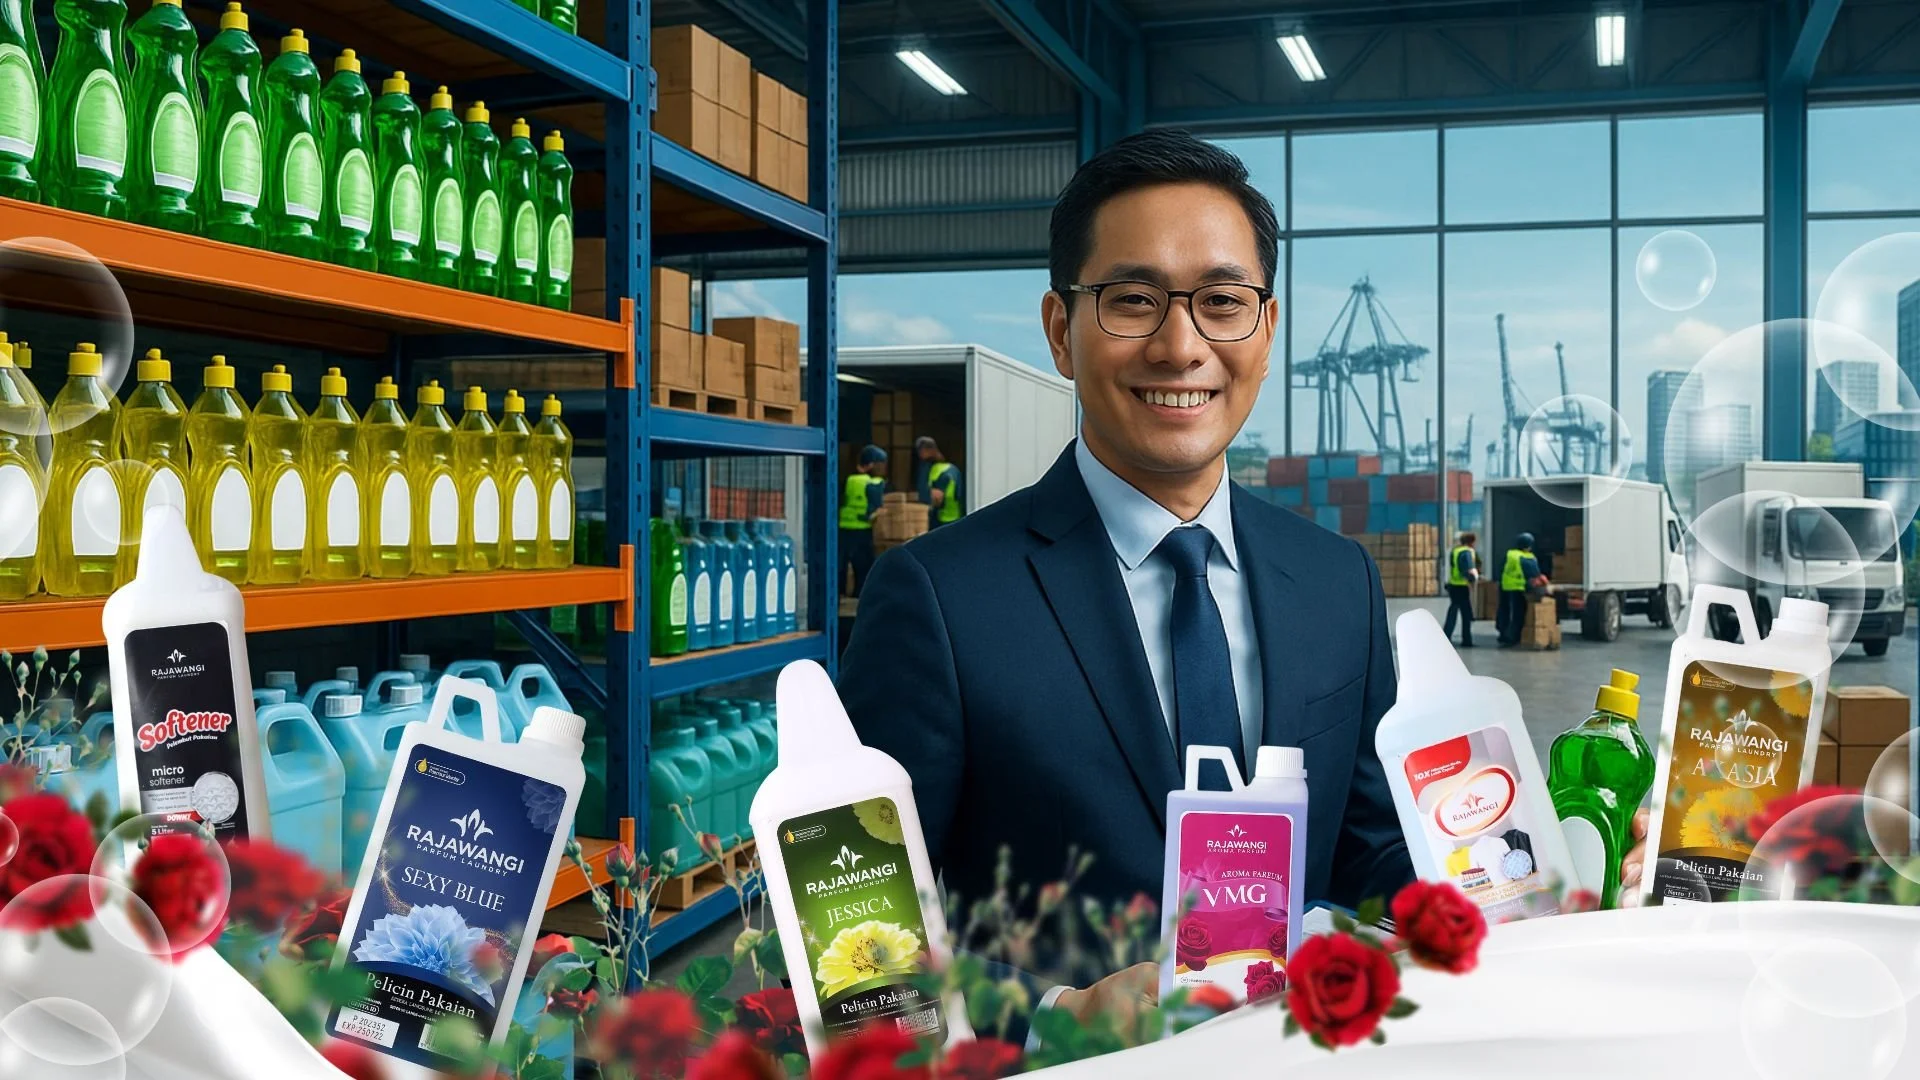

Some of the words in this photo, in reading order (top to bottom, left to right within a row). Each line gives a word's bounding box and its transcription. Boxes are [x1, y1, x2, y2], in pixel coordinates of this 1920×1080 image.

[151, 664, 205, 676] RAJAWANGI
[137, 709, 232, 752] Softener
[1690, 727, 1789, 753] RAJAWANGI
[1737, 748, 1777, 758] LAUNDRY
[149, 777, 186, 787] softener
[152, 765, 184, 776] micro
[1413, 769, 1430, 781] 10X
[1452, 801, 1499, 822] RAJAWANGI
[158, 827, 175, 835] Liter
[406, 824, 525, 874] RAJAWANGI
[1206, 840, 1267, 850] RAJAWANGI
[416, 844, 456, 861] PARFUM
[461, 858, 507, 877] LAUNDRY
[1675, 859, 1715, 875] Pelicin
[1719, 865, 1763, 882] Pakaian
[806, 862, 898, 895] RAJAWANGI
[1221, 870, 1251, 878] AROMA
[1252, 870, 1283, 881] PARFUM
[401, 866, 453, 895] SEXY
[454, 882, 506, 912] BLUE
[818, 888, 850, 899] PARFUM
[853, 878, 890, 890] LAUNDRY
[1202, 884, 1267, 908] VMG
[826, 895, 893, 928] JESSICA
[365, 972, 415, 1000] Pelicin
[419, 989, 476, 1019] Pakaian
[840, 998, 877, 1014] Pelicin
[878, 989, 919, 1005] Pakaian
